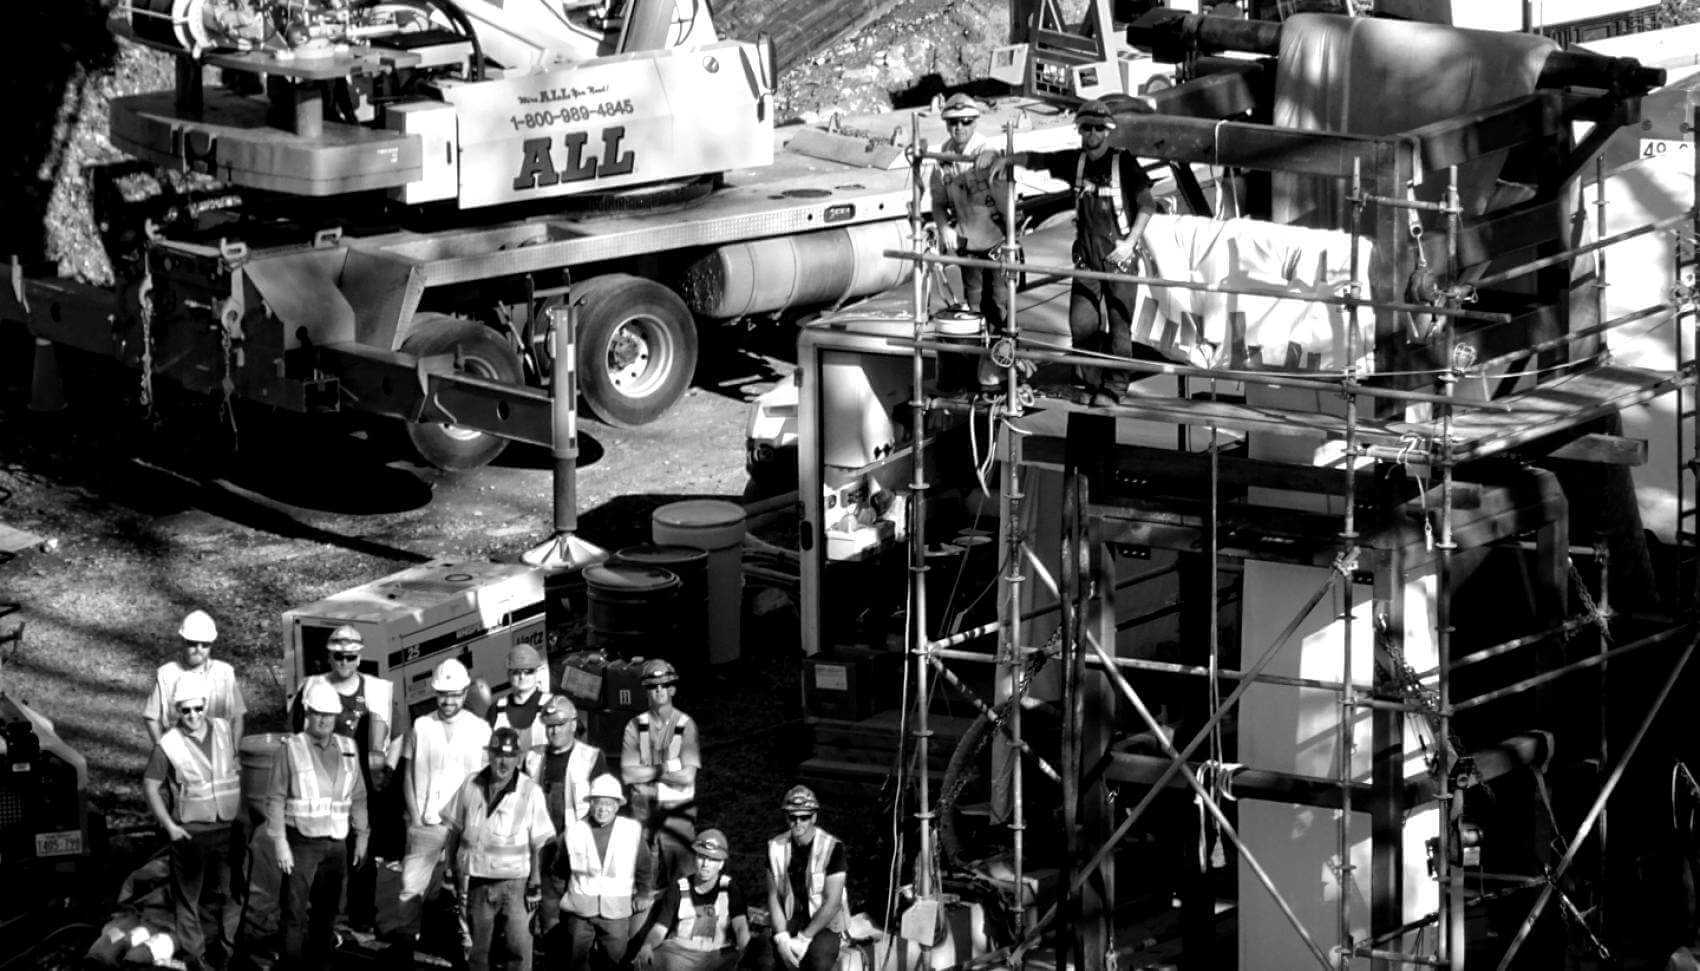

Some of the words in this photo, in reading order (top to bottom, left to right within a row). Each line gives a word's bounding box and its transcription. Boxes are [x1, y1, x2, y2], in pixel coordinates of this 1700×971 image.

[540, 88, 571, 103] ALL
[510, 99, 635, 131] 1-800-989-4845
[513, 125, 635, 191] ALL
[407, 644, 420, 661] 25
